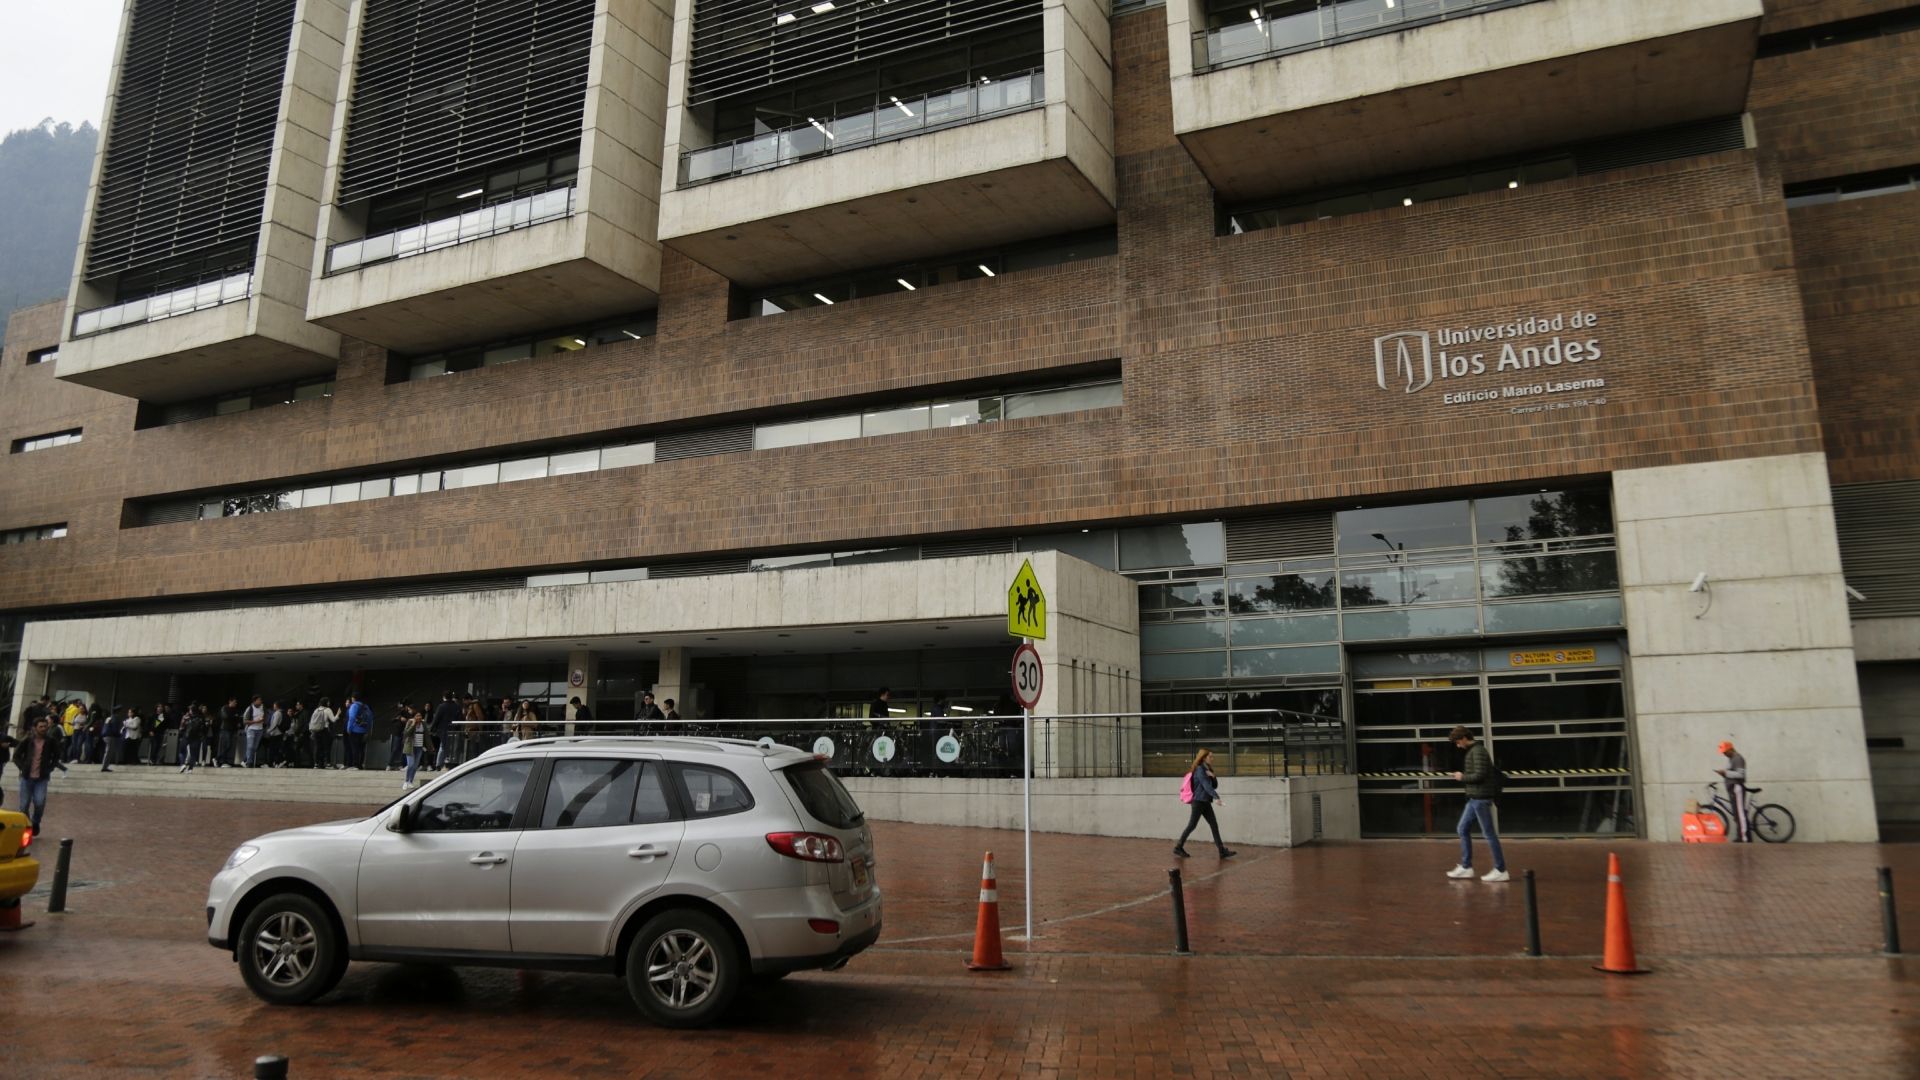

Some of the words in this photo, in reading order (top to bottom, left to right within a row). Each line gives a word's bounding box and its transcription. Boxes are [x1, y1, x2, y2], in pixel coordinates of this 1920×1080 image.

[1438, 313, 1563, 346] Universidad
[1571, 311, 1598, 329] de
[1440, 351, 1486, 378] los
[1497, 337, 1602, 371] Andes
[1444, 389, 1498, 405] Edificio
[1503, 382, 1543, 398] Mario
[1546, 377, 1605, 393] Laserna
[1018, 660, 1038, 692] 30
